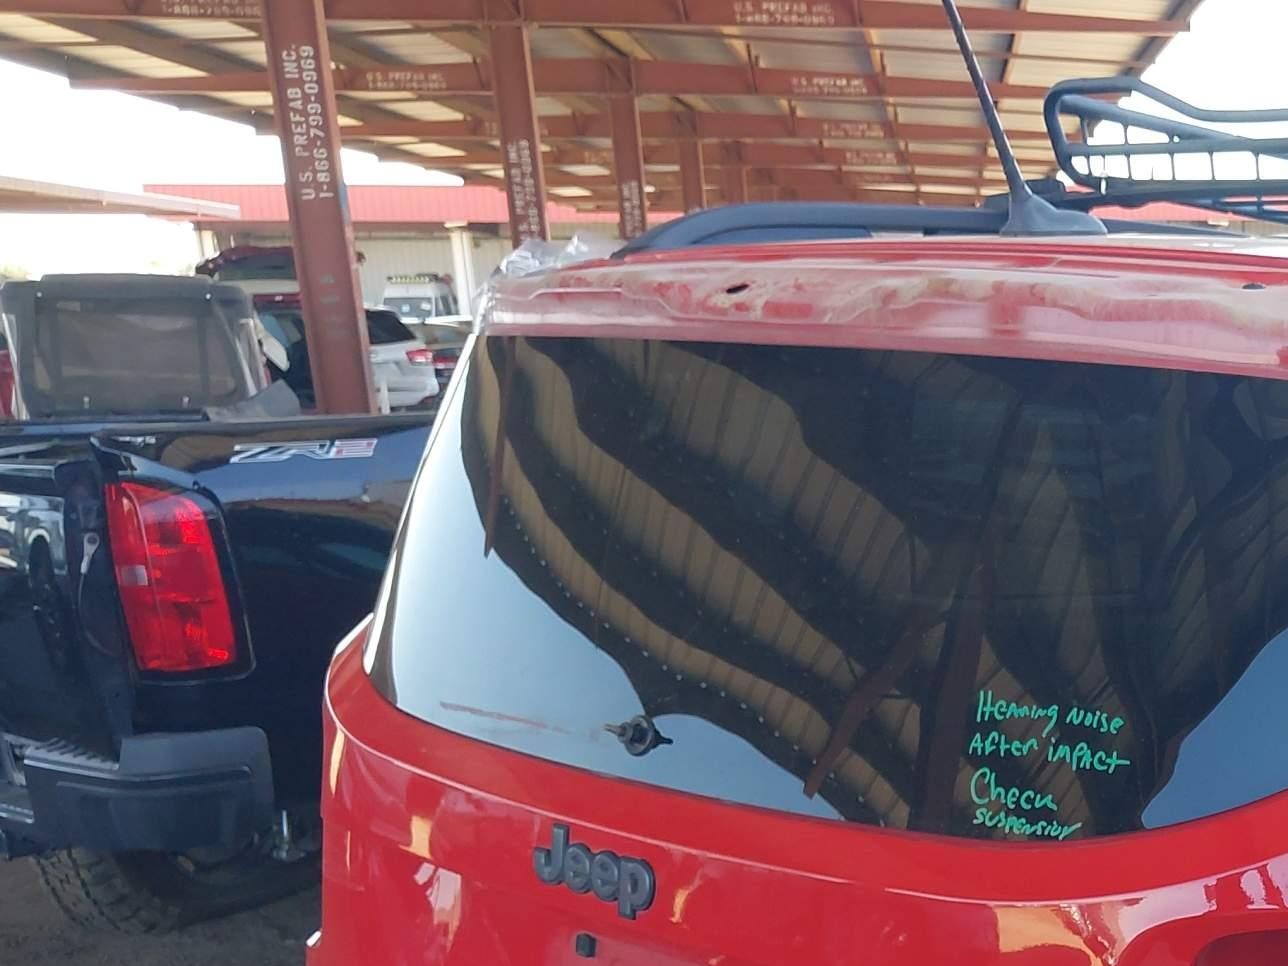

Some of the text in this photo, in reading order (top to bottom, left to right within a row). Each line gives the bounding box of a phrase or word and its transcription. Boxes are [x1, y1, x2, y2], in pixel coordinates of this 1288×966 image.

[282, 44, 316, 200] U.S. PREFAB INC.
[300, 46, 334, 198] 1-866-799-0969
[533, 822, 656, 920] Jeep
